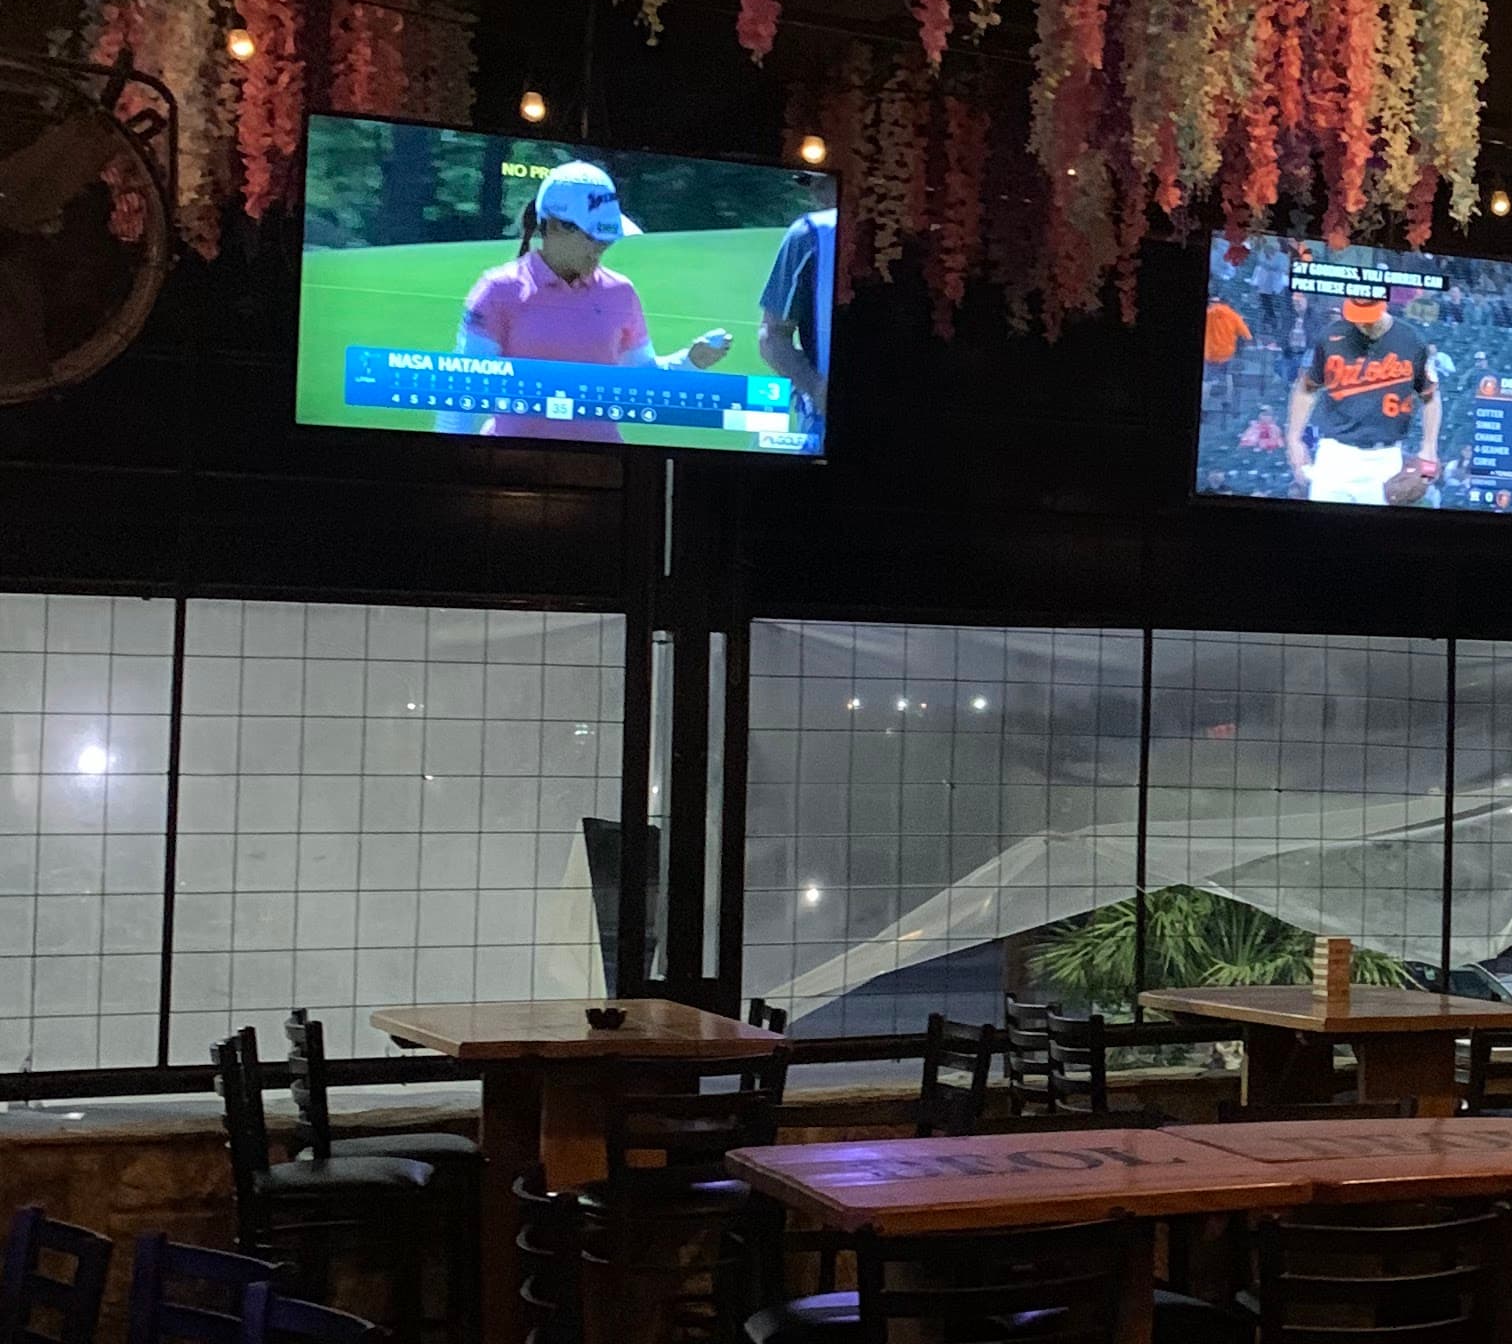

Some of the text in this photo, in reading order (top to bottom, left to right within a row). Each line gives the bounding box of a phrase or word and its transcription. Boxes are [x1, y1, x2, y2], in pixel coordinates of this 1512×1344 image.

[502, 162, 528, 178] NO
[389, 352, 514, 376] NASA HATAOKA
